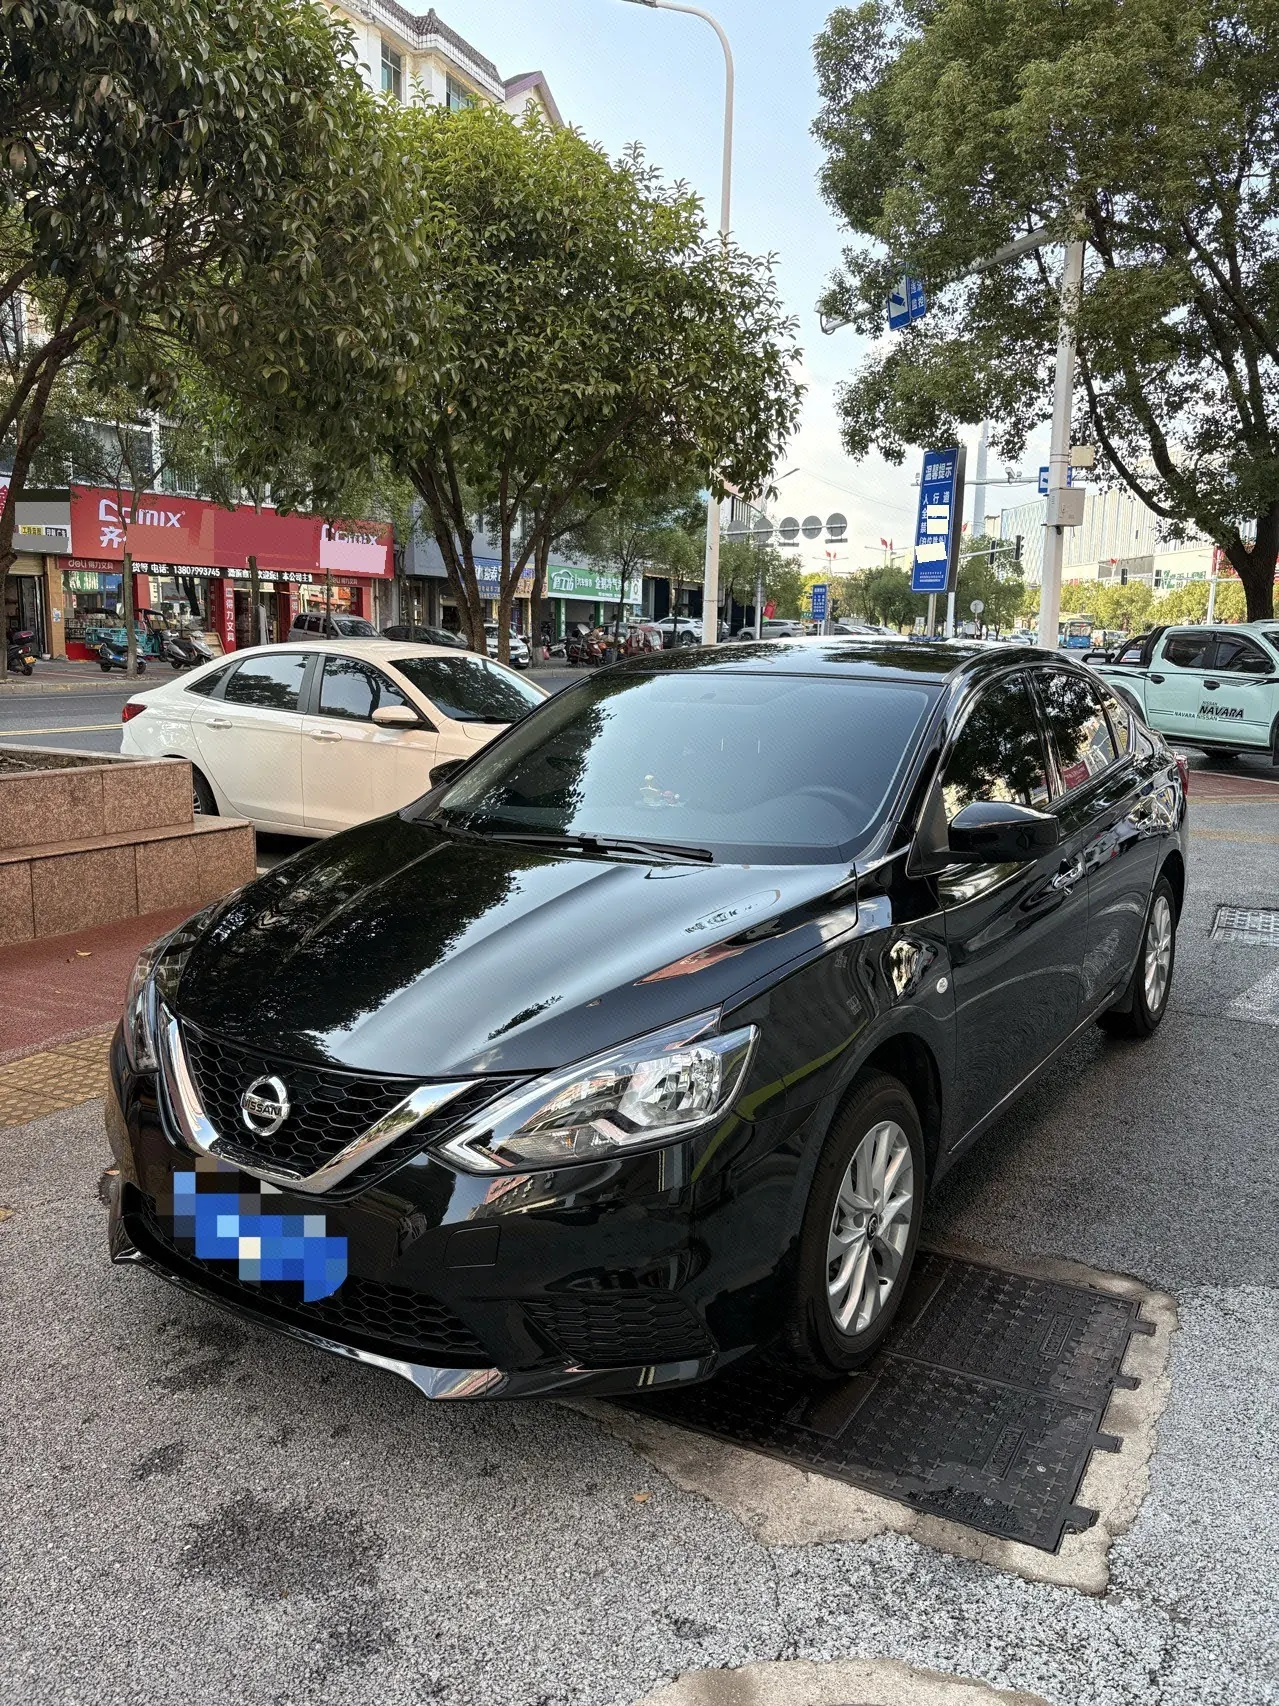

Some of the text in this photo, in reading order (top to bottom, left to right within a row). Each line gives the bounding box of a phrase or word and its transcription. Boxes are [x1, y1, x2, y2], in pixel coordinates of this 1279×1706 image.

[924, 462, 953, 481] 温馨提示
[922, 490, 950, 505] 人行道
[88, 561, 114, 570] 得力文具
[150, 564, 170, 574] 电话:
[173, 565, 221, 577] 13807993745
[225, 599, 235, 642] 得力文具
[1174, 711, 1196, 719] NAVARA
[1199, 705, 1245, 718] NAVARA
[244, 1098, 283, 1118] NISSAN
